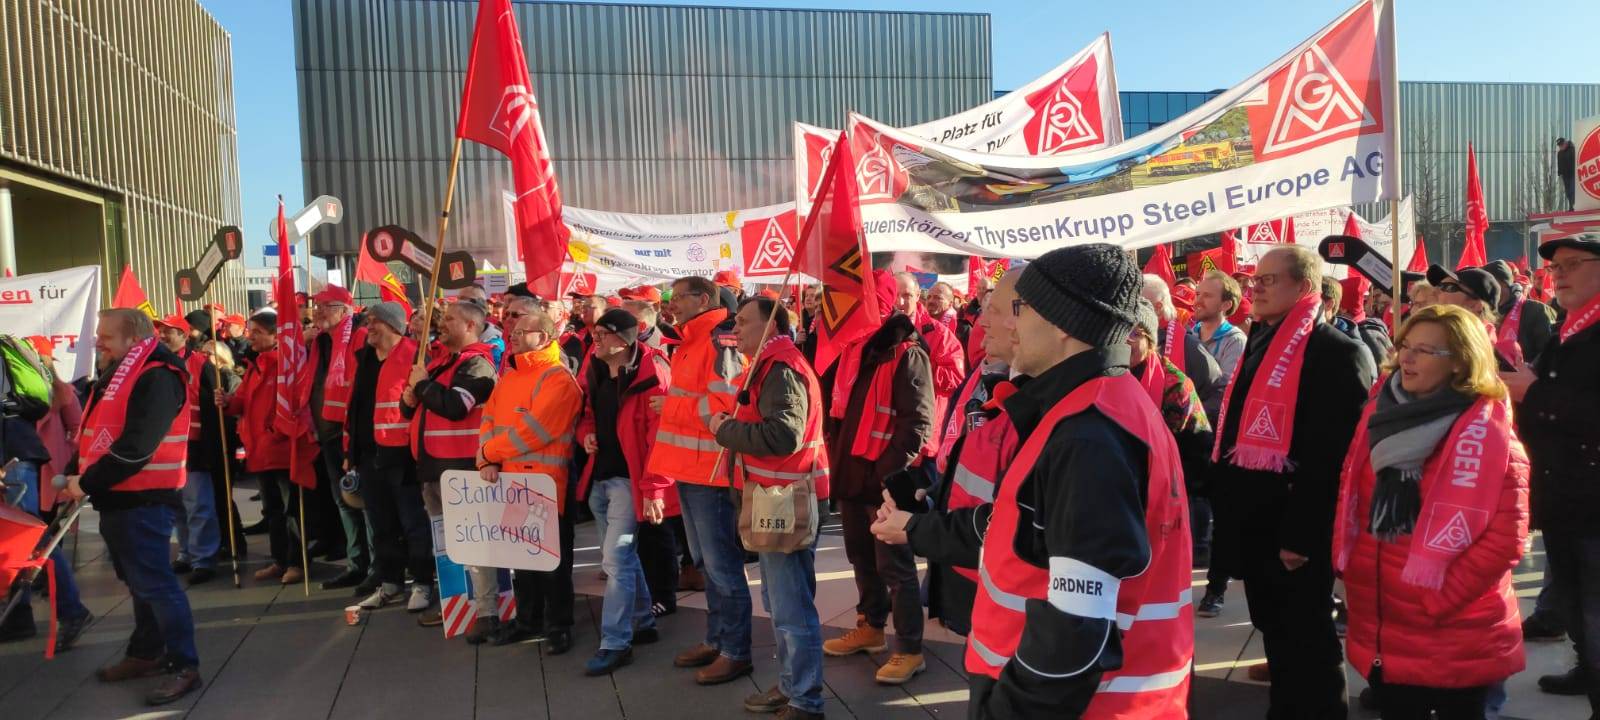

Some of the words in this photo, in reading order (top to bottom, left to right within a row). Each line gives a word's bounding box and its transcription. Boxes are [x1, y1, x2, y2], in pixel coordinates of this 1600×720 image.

[941, 122, 978, 144] Platz
[981, 111, 1004, 130] für
[974, 214, 1134, 249] ThyssenKrupp
[1143, 192, 1216, 226] Steel
[1225, 166, 1330, 209] Europe
[1340, 151, 1384, 182] AG
[655, 247, 672, 257] mit
[671, 266, 714, 277] Elevator
[39, 285, 67, 299] für
[456, 512, 541, 556] sicherung
[1052, 577, 1104, 596] ORDNER
